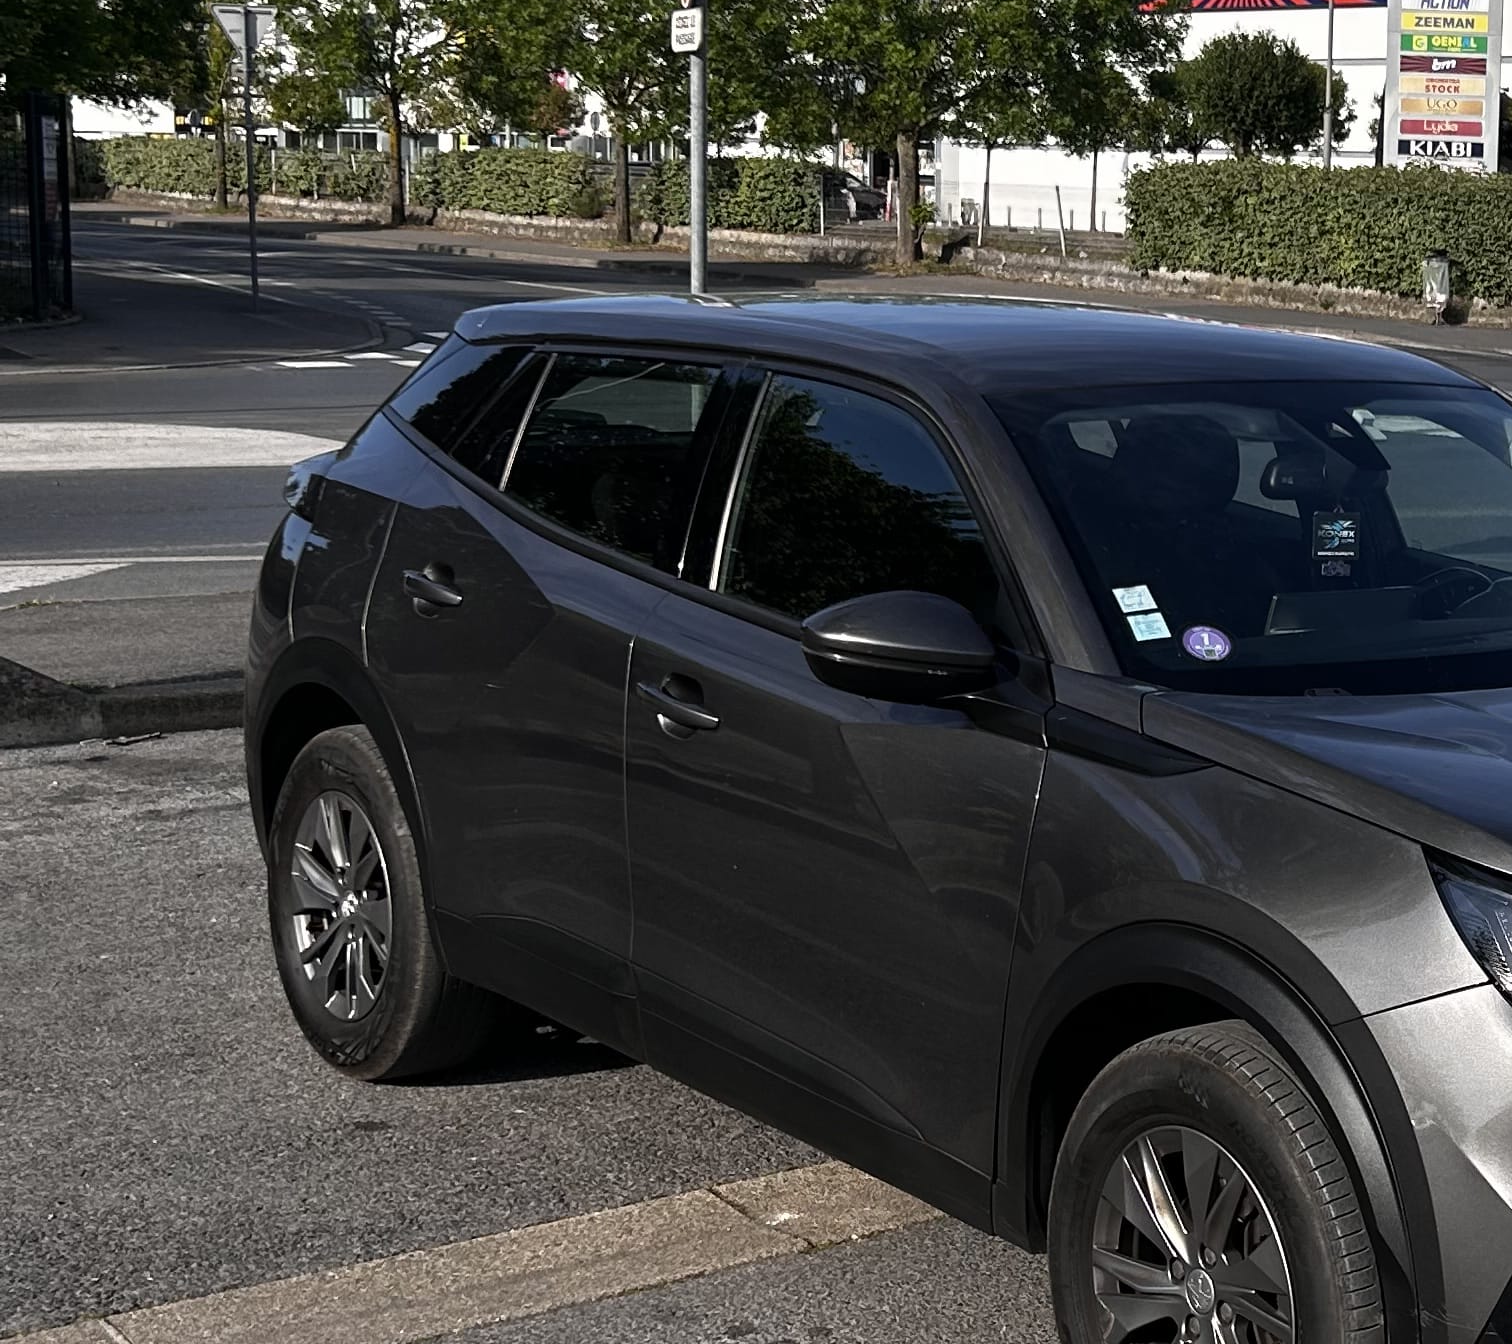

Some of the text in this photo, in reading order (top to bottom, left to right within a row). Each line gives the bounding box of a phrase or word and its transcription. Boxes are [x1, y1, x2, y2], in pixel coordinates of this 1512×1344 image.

[1414, 16, 1475, 29] ZEEMAN
[1425, 84, 1460, 94] STOCK
[1410, 140, 1472, 157] KIABI
